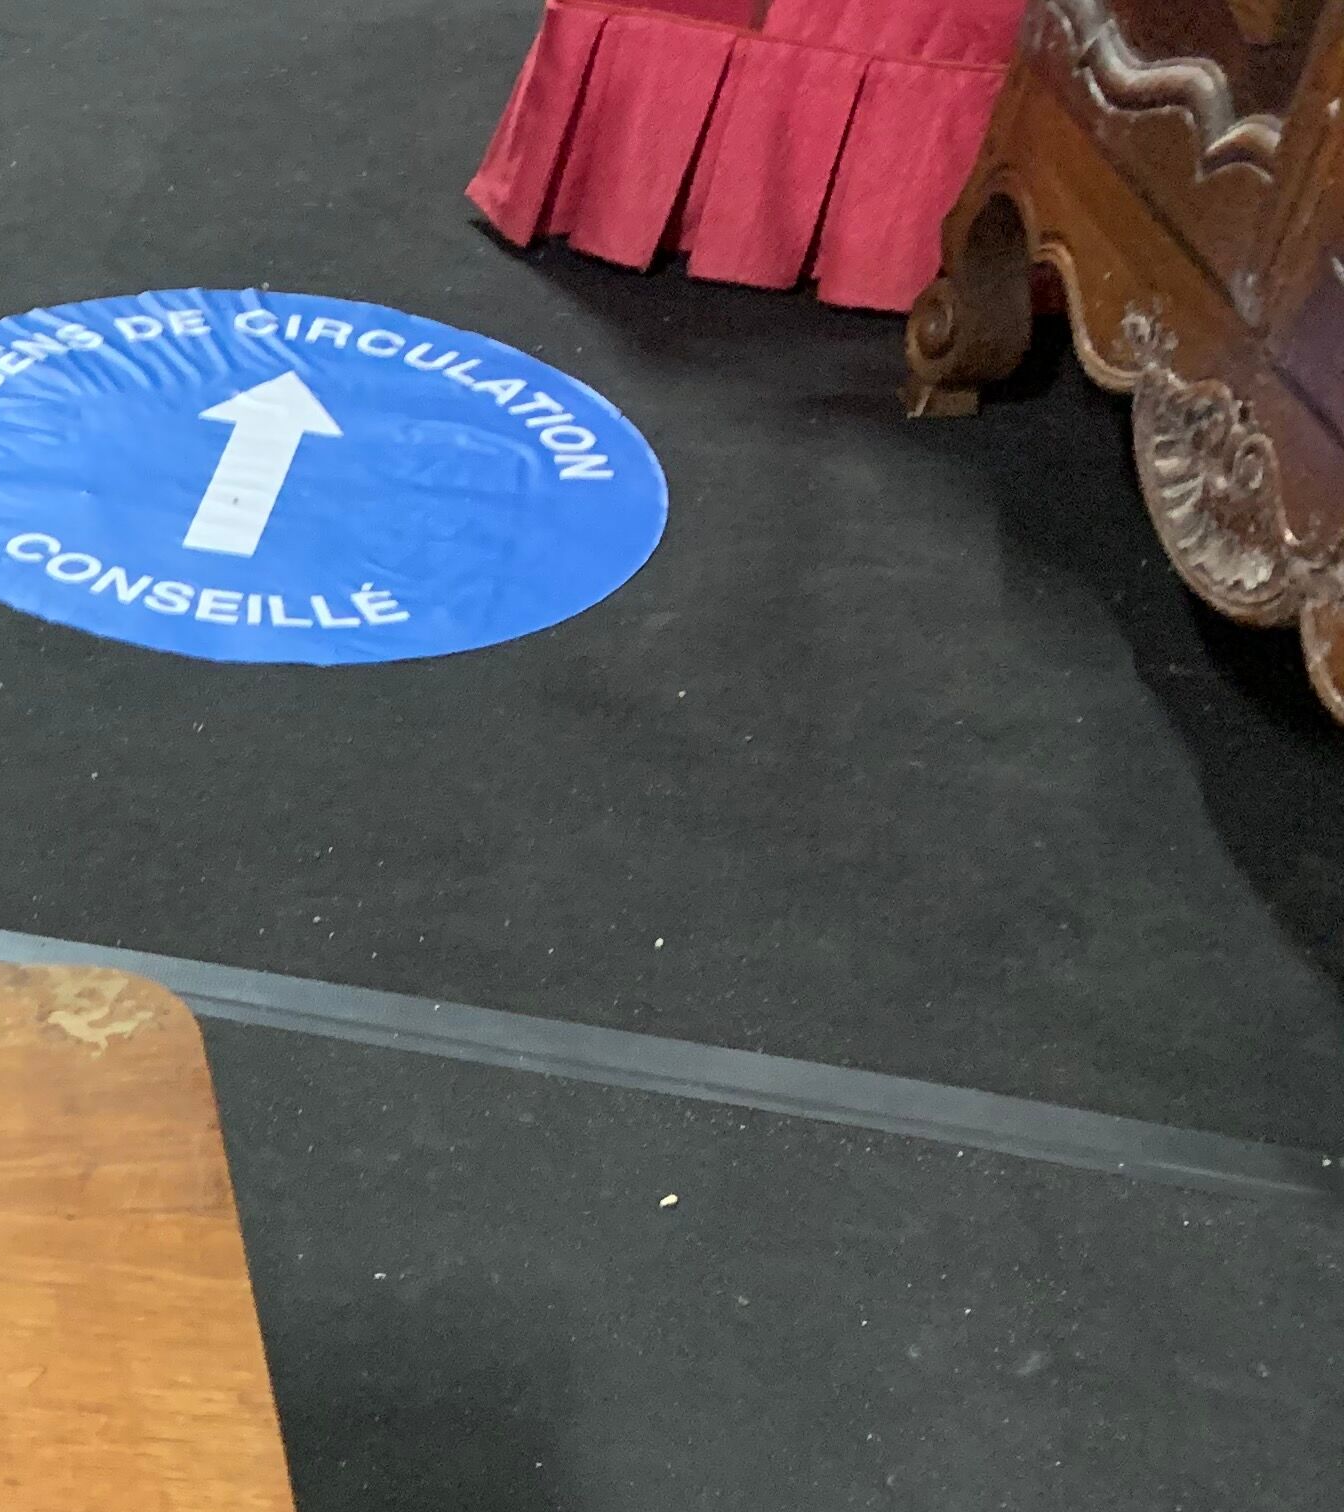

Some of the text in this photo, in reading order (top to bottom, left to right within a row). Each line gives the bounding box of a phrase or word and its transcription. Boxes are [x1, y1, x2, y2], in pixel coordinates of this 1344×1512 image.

[114, 309, 211, 342] DE
[234, 309, 614, 481] CIRCULATION
[5, 531, 410, 628] CONSEILLÉ
